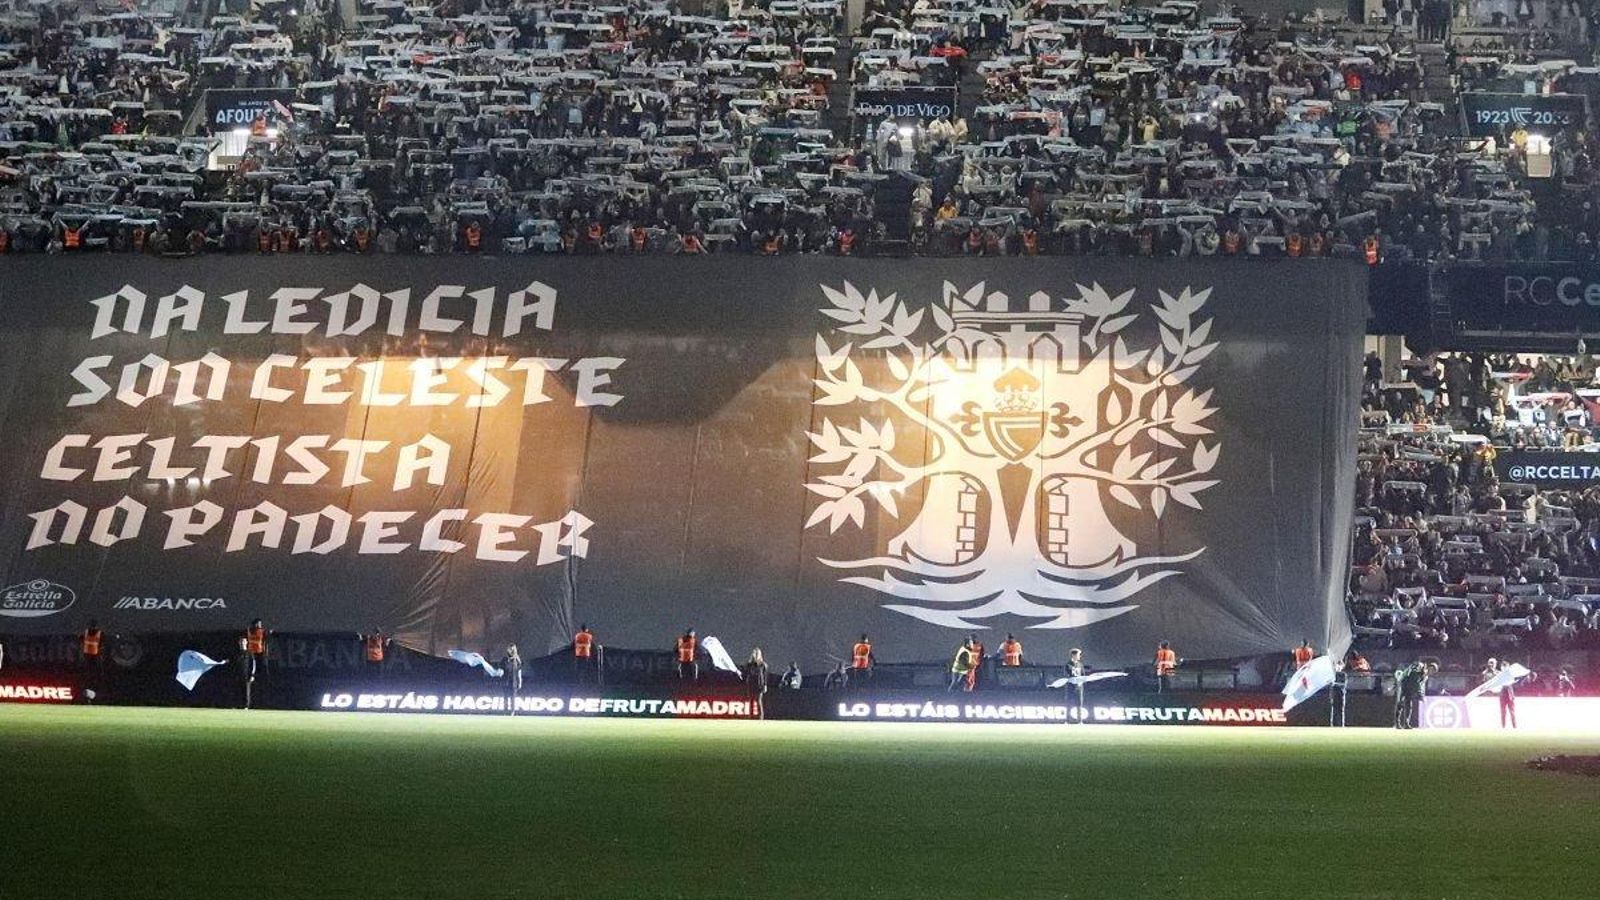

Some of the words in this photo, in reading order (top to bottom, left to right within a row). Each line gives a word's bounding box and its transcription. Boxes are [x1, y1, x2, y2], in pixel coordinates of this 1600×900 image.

[897, 104, 915, 117] DE
[1475, 110, 1510, 123] 1923
[89, 284, 206, 340] NA
[220, 281, 559, 337] LEDICIA
[66, 352, 231, 408] SON
[250, 353, 628, 408] CELESTE
[40, 433, 452, 491] CELTISTA
[1508, 465, 1600, 481] @RCCELTA
[26, 496, 148, 550] NO
[163, 500, 596, 566] PADECER
[4, 589, 63, 600] Estrella
[3, 599, 56, 609] Galicia
[320, 693, 353, 708] LO
[356, 691, 440, 710] ESTÁIS
[837, 702, 871, 717] LO
[875, 700, 961, 718] ESTÁIS
